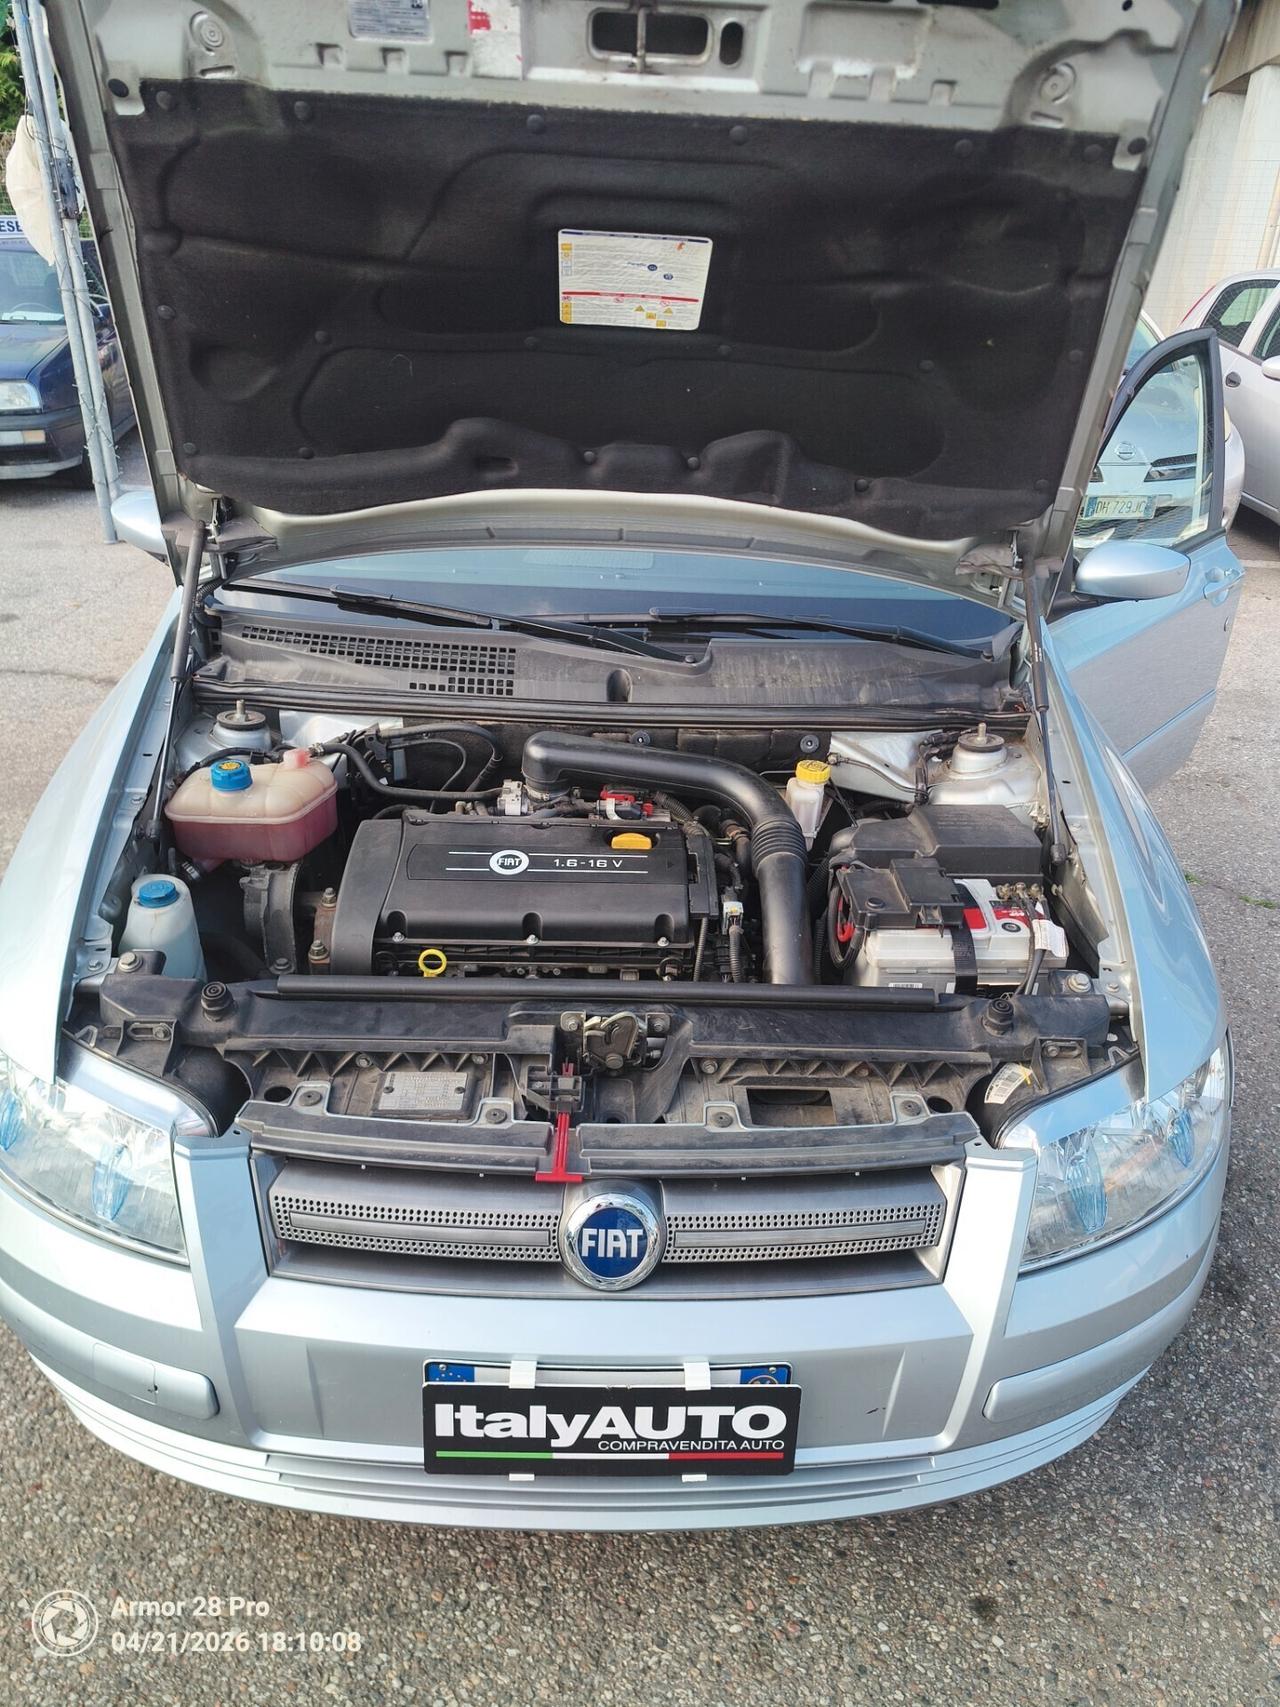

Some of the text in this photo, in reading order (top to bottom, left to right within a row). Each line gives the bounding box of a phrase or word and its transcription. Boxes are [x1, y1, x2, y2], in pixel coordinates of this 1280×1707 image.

[497, 857, 522, 867] FIAT
[581, 1228, 644, 1258] FIAT
[434, 1403, 788, 1448] ItalyAUTO
[597, 1439, 785, 1451] COMPRAVENDITA AUTO
